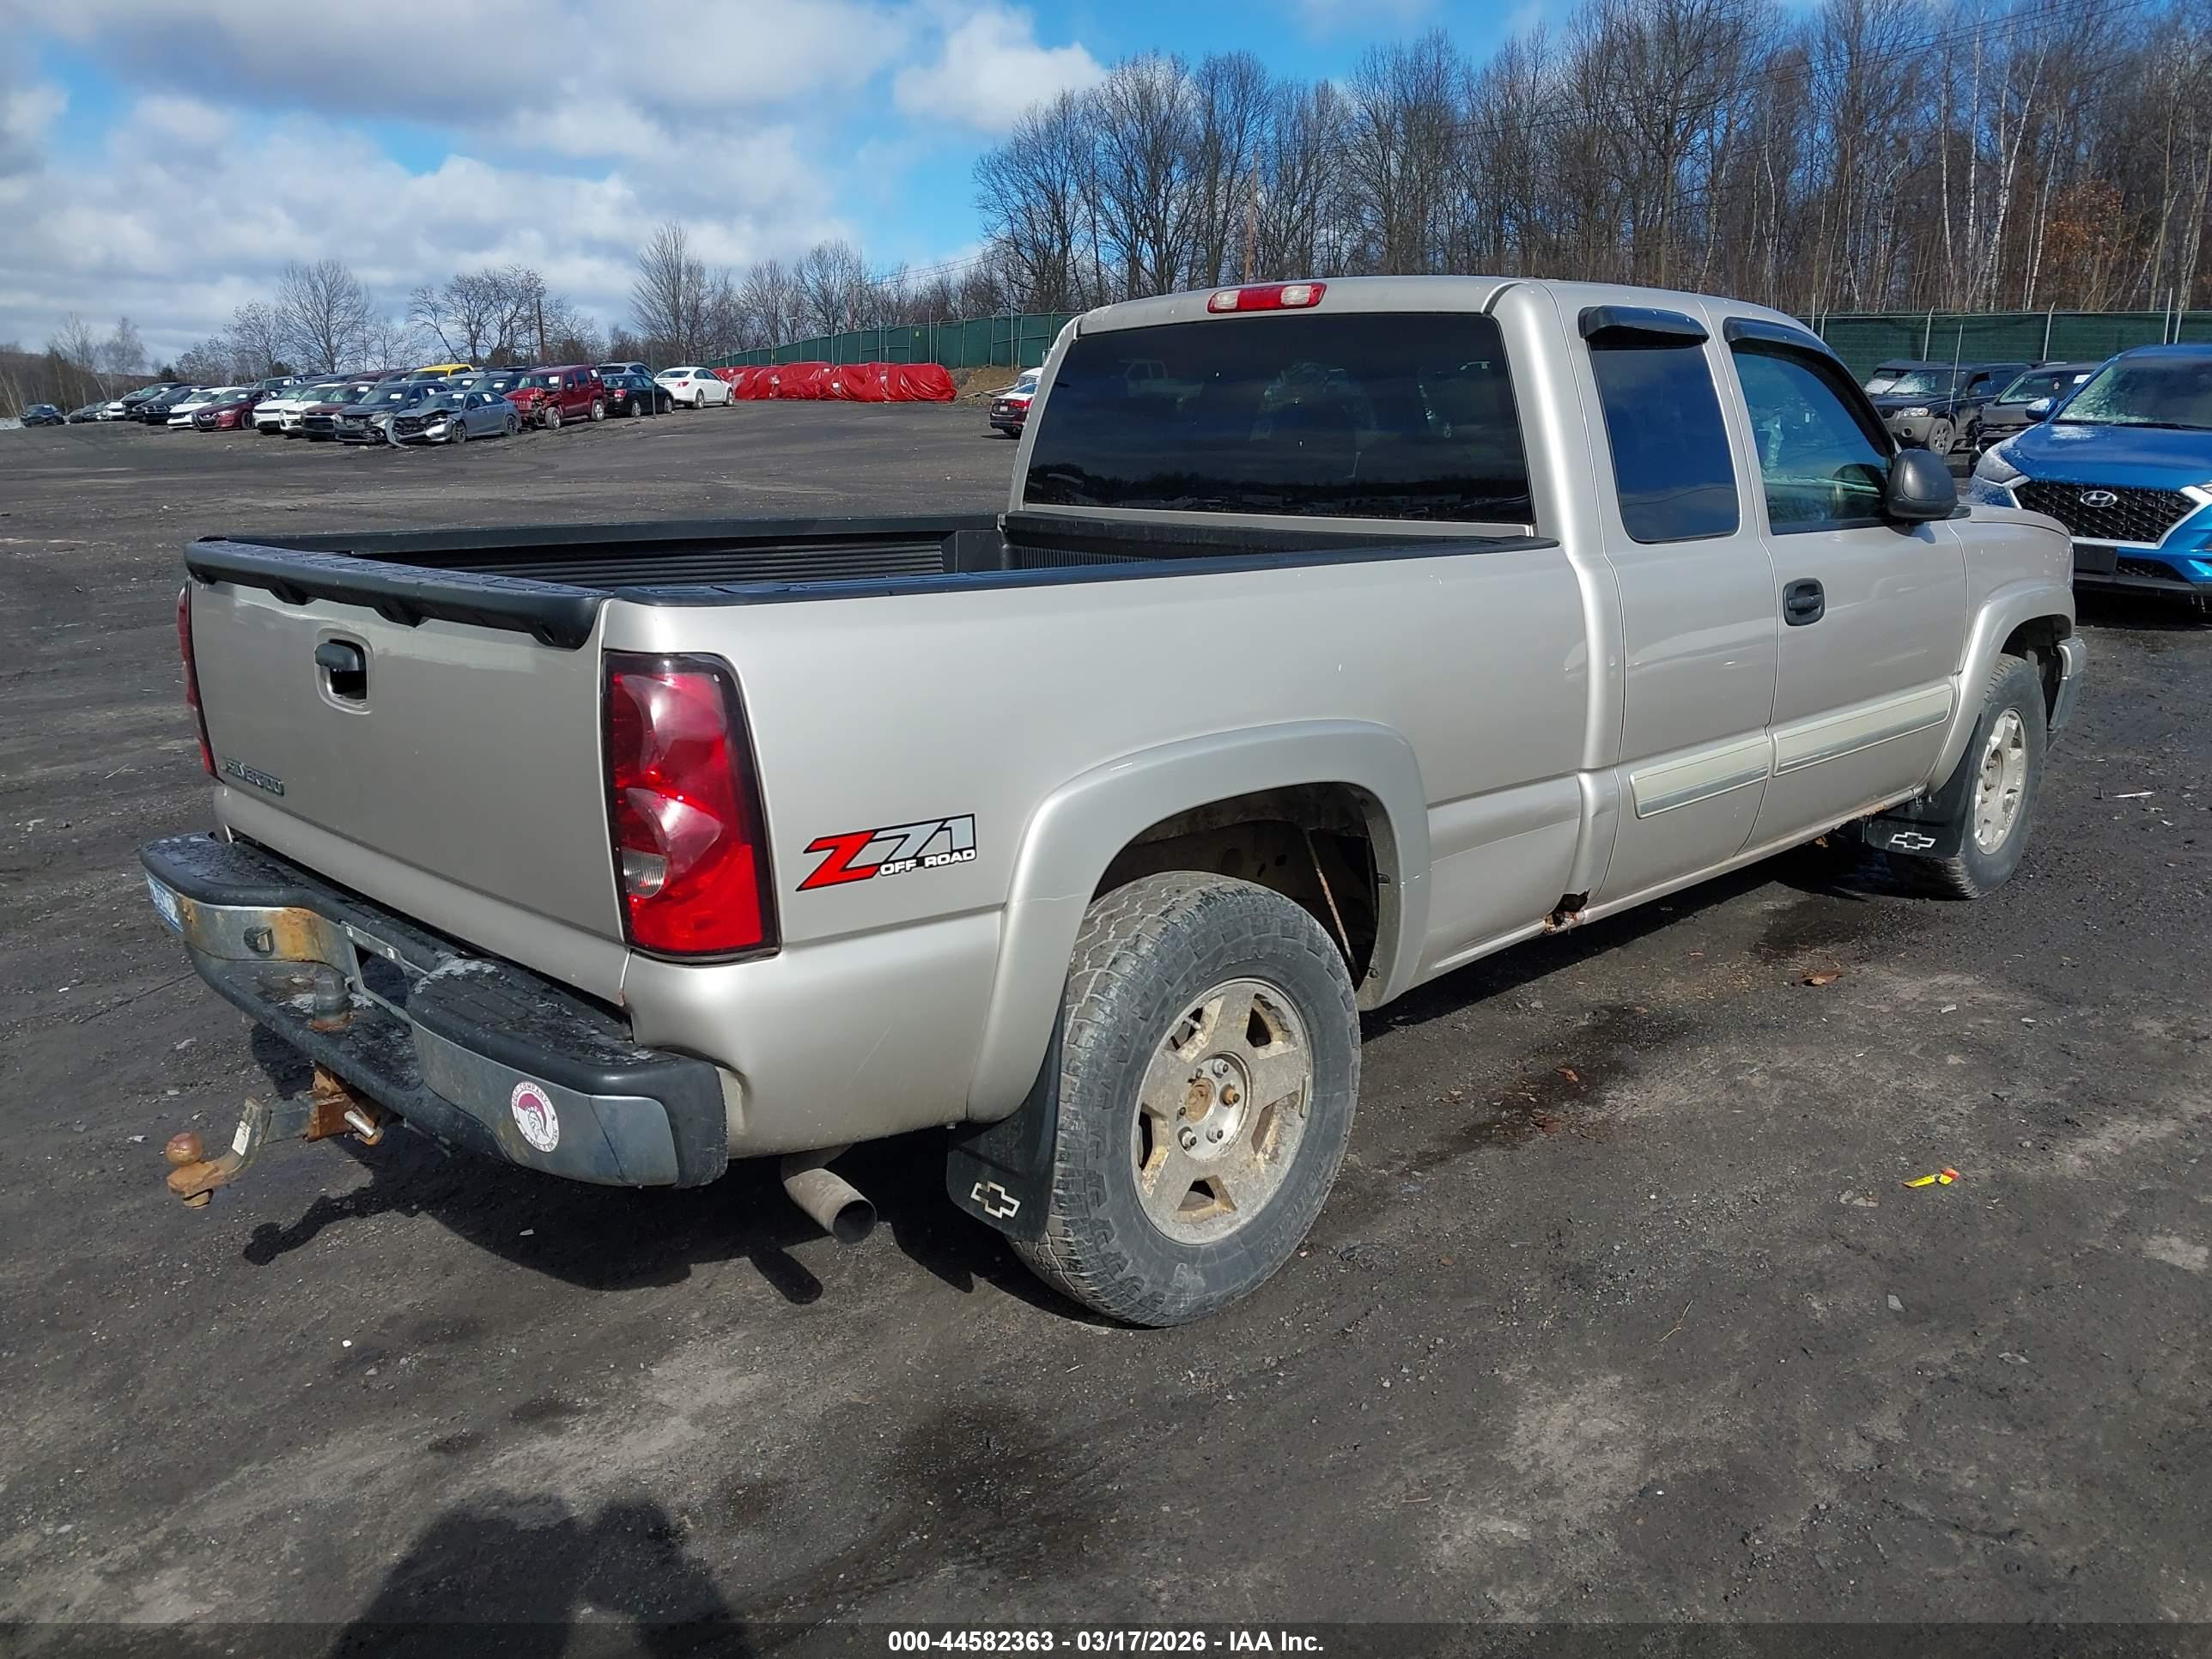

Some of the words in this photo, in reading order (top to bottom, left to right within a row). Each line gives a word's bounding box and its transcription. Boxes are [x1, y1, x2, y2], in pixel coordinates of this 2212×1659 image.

[795, 813, 975, 892] Z71
[879, 859, 917, 877] OFF
[923, 849, 977, 868] ROAD
